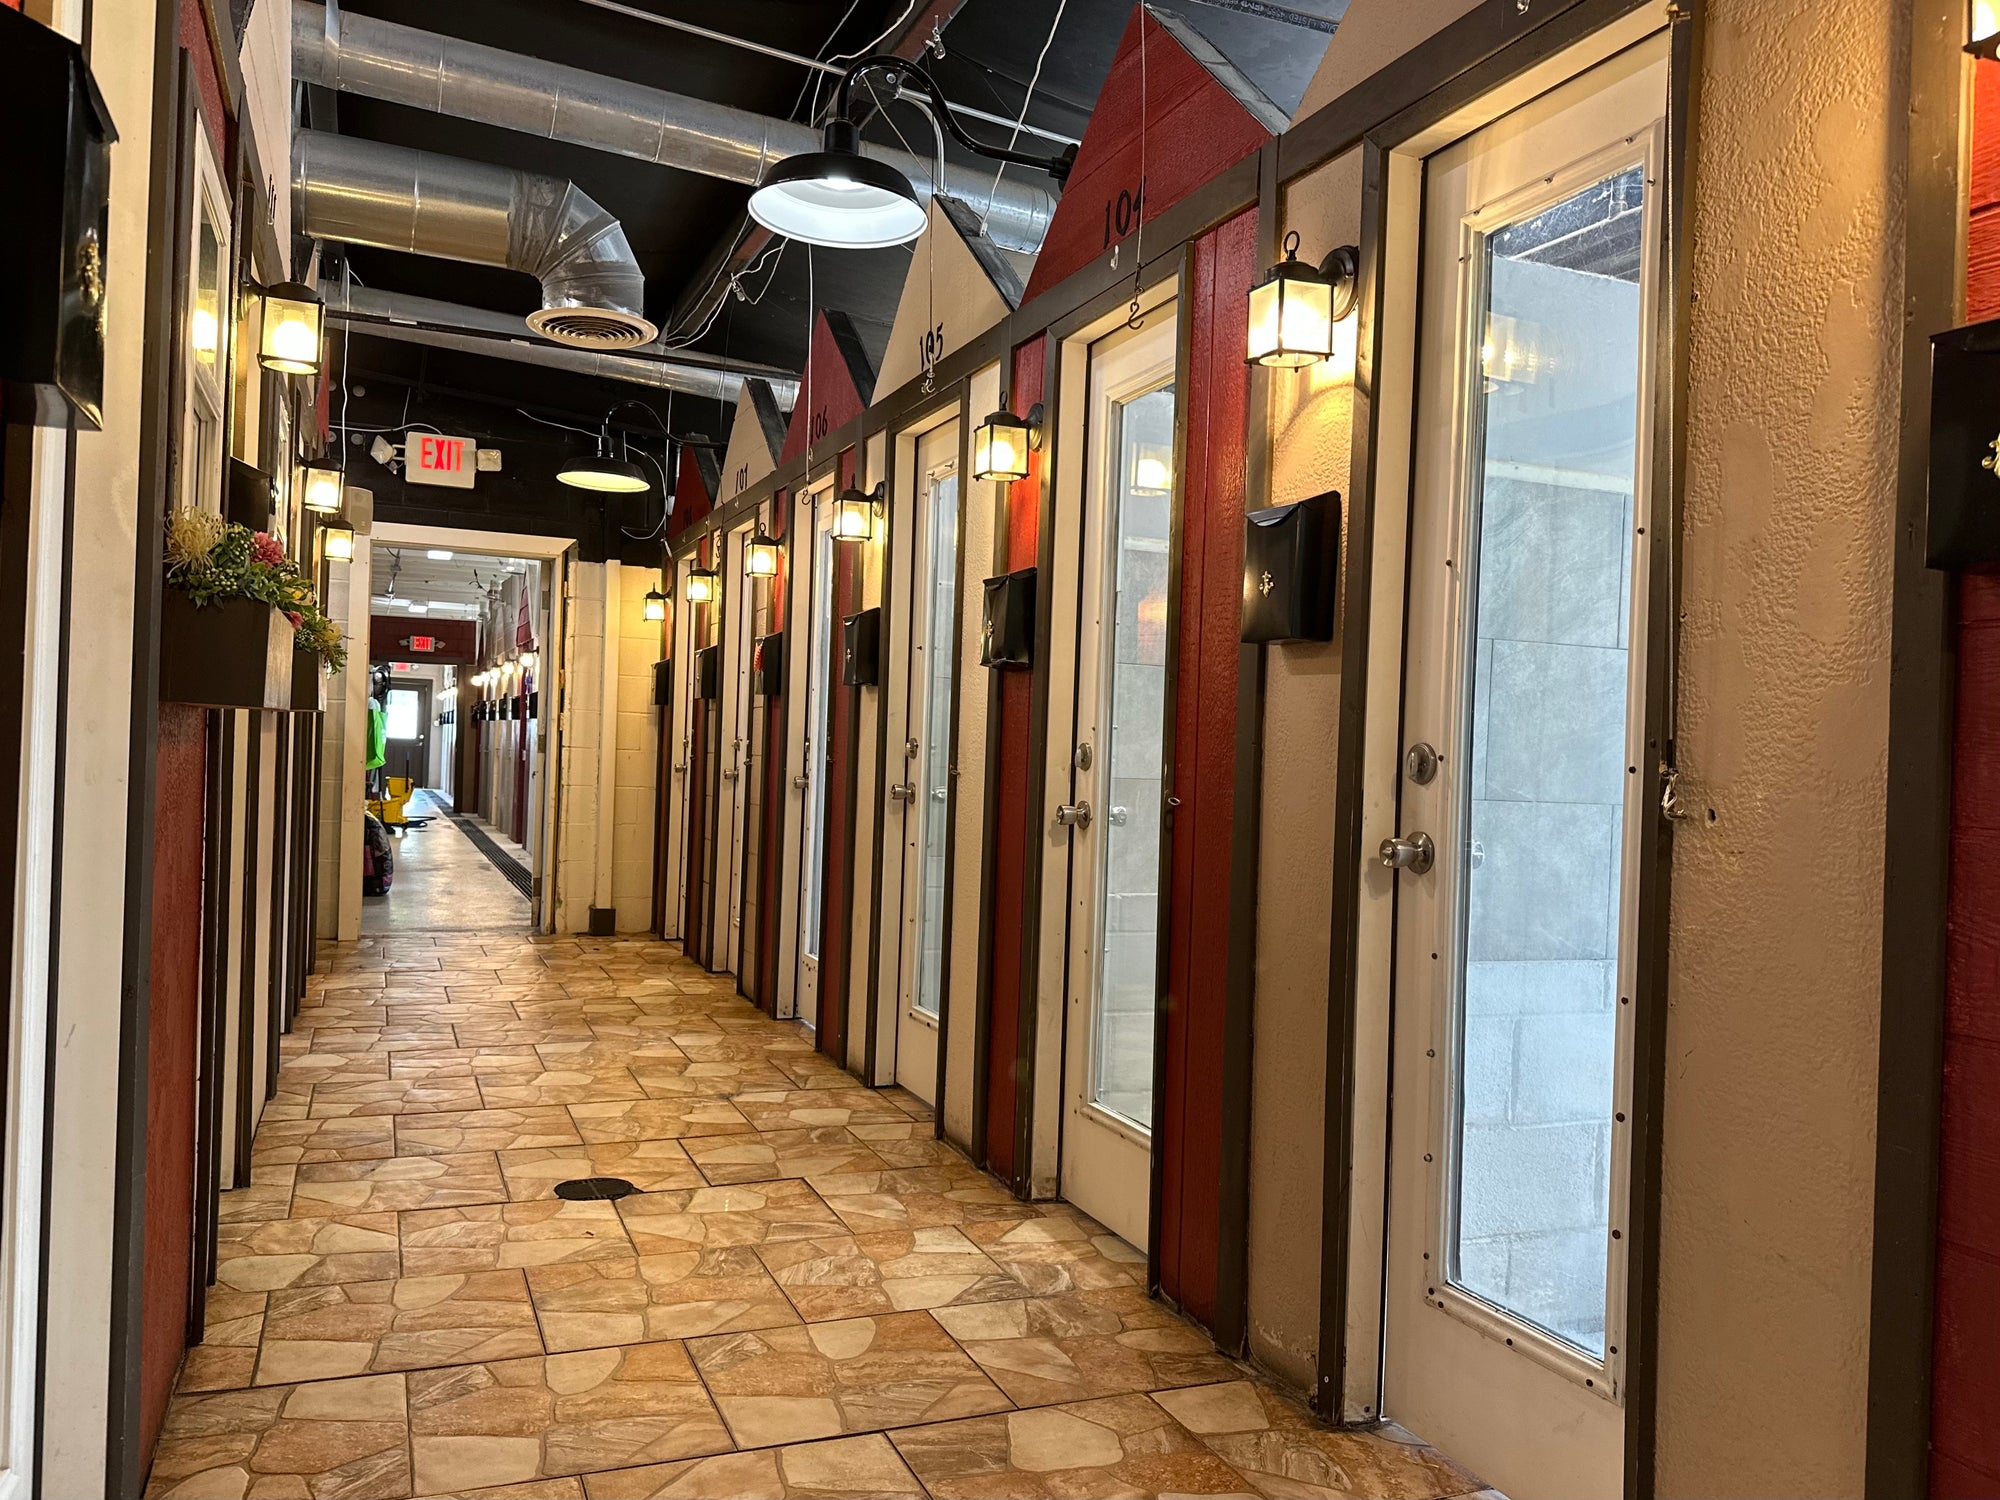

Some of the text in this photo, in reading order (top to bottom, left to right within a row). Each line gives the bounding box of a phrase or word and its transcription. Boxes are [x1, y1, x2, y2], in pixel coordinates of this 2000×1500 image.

[919, 322, 944, 371] 105
[810, 404, 828, 446] 106
[420, 436, 465, 472] EXIT
[414, 636, 432, 650] EXIT
